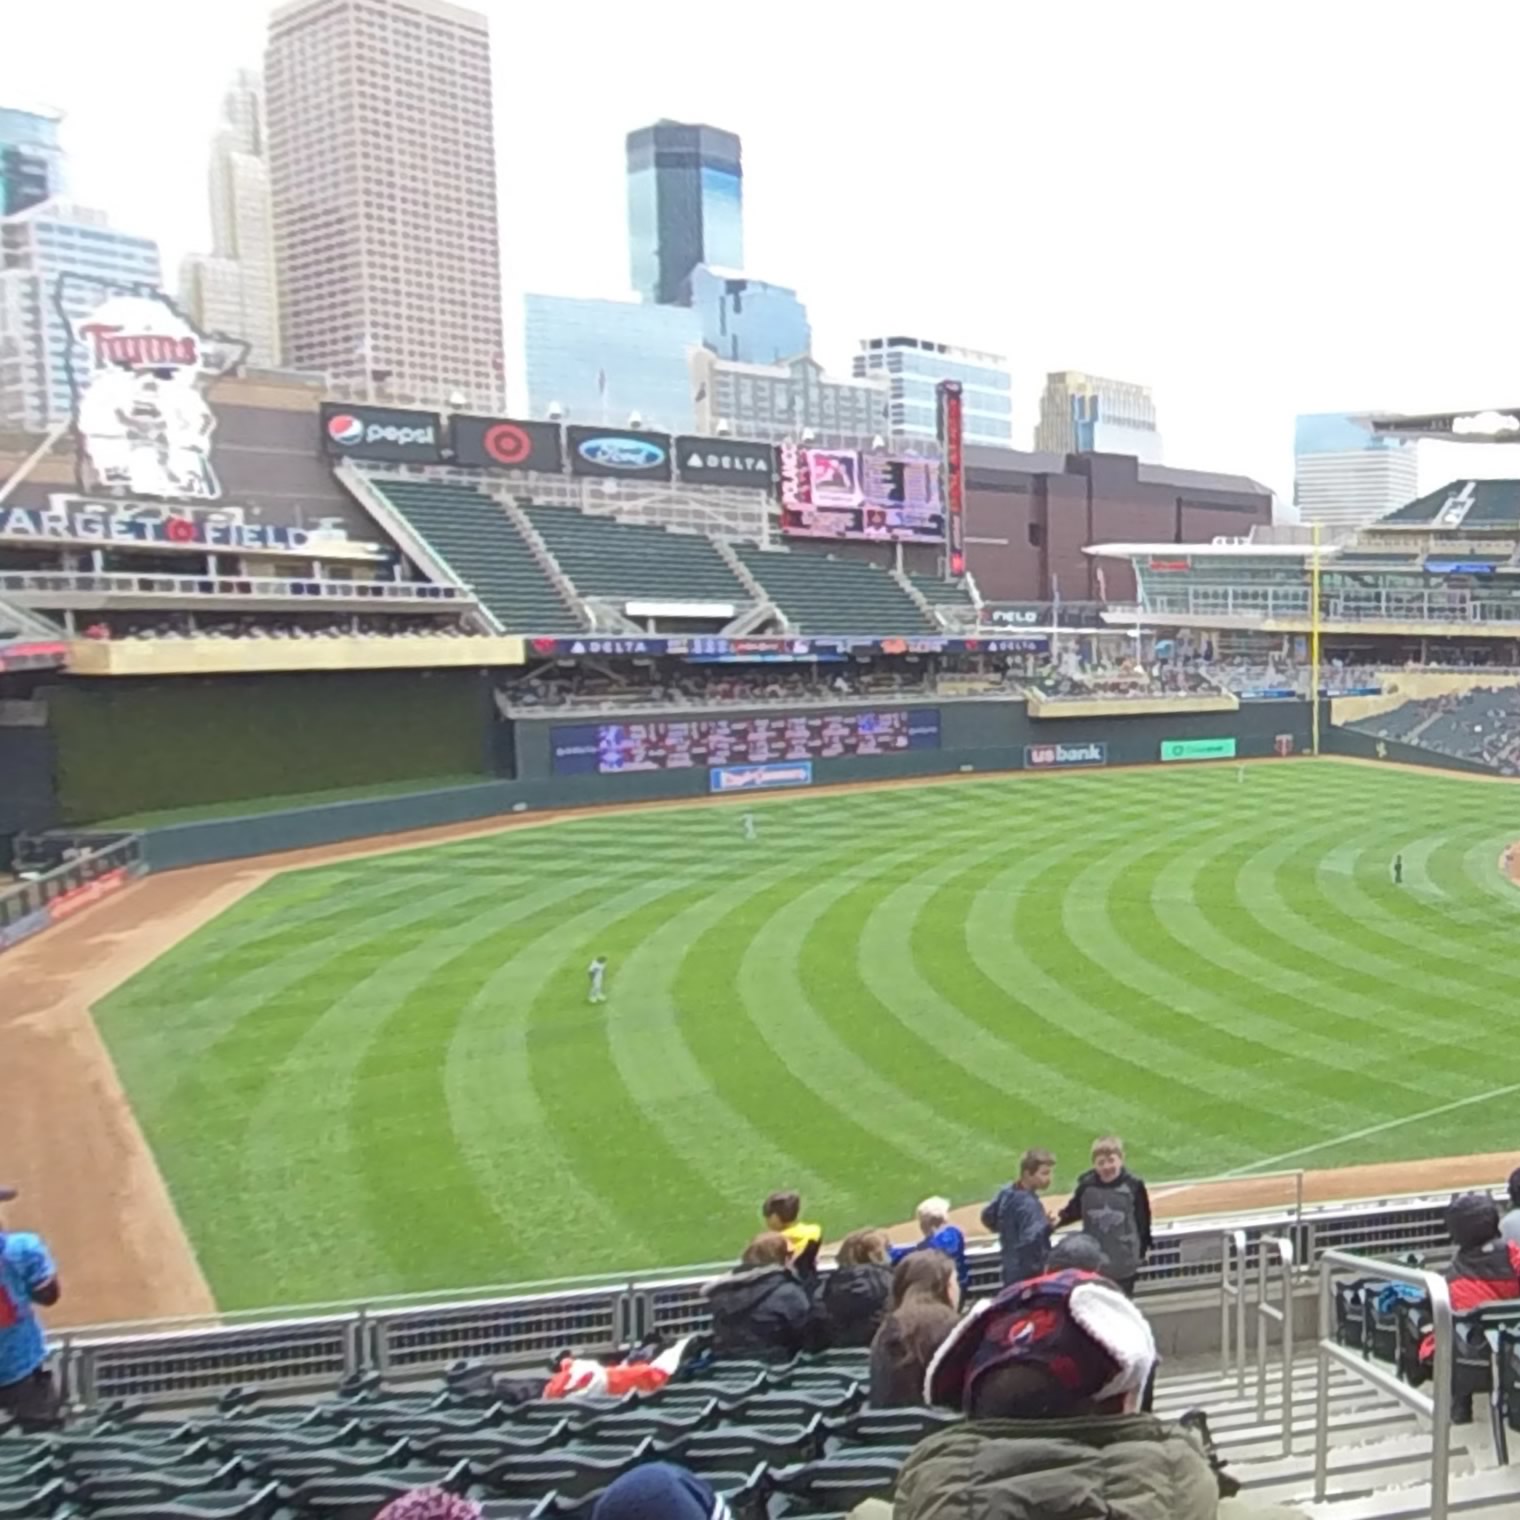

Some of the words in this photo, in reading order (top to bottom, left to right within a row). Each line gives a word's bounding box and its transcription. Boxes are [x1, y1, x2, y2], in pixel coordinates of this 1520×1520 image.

[79, 323, 198, 369] Twins
[366, 424, 434, 445] pepsi
[706, 454, 767, 472] DELTA
[0, 506, 162, 542] ARGET
[204, 521, 310, 549] FIELD
[589, 641, 647, 654] DELTA
